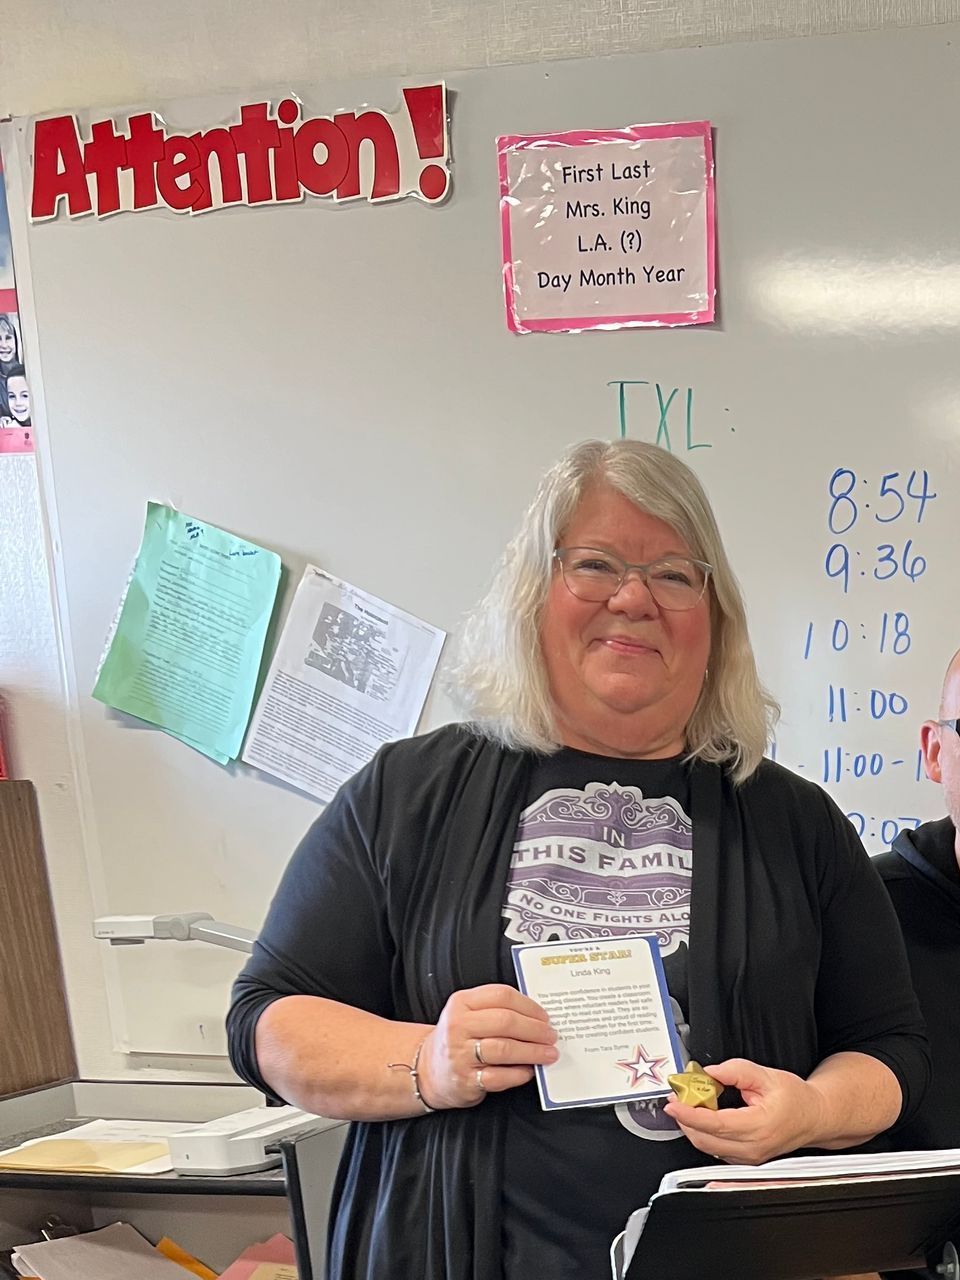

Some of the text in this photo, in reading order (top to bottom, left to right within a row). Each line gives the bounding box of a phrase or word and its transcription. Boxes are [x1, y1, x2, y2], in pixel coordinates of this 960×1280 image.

[30, 82, 451, 219] Attention!
[562, 159, 651, 184] First Last
[566, 196, 651, 220] Mrs. King
[577, 229, 642, 254] L.A. (?)
[537, 265, 686, 293] Day Month Year
[828, 468, 937, 535] 8:54
[825, 539, 928, 594] 9:36
[829, 684, 908, 724] 11:00
[823, 746, 884, 783] 11:00
[603, 826, 626, 848] IN
[513, 844, 693, 872] THIS FAMIL
[550, 906, 587, 920] ONE
[592, 912, 653, 926] FIGHTS
[659, 911, 691, 924] ALO
[541, 953, 587, 966] SUPER
[570, 966, 612, 978] Linda King
